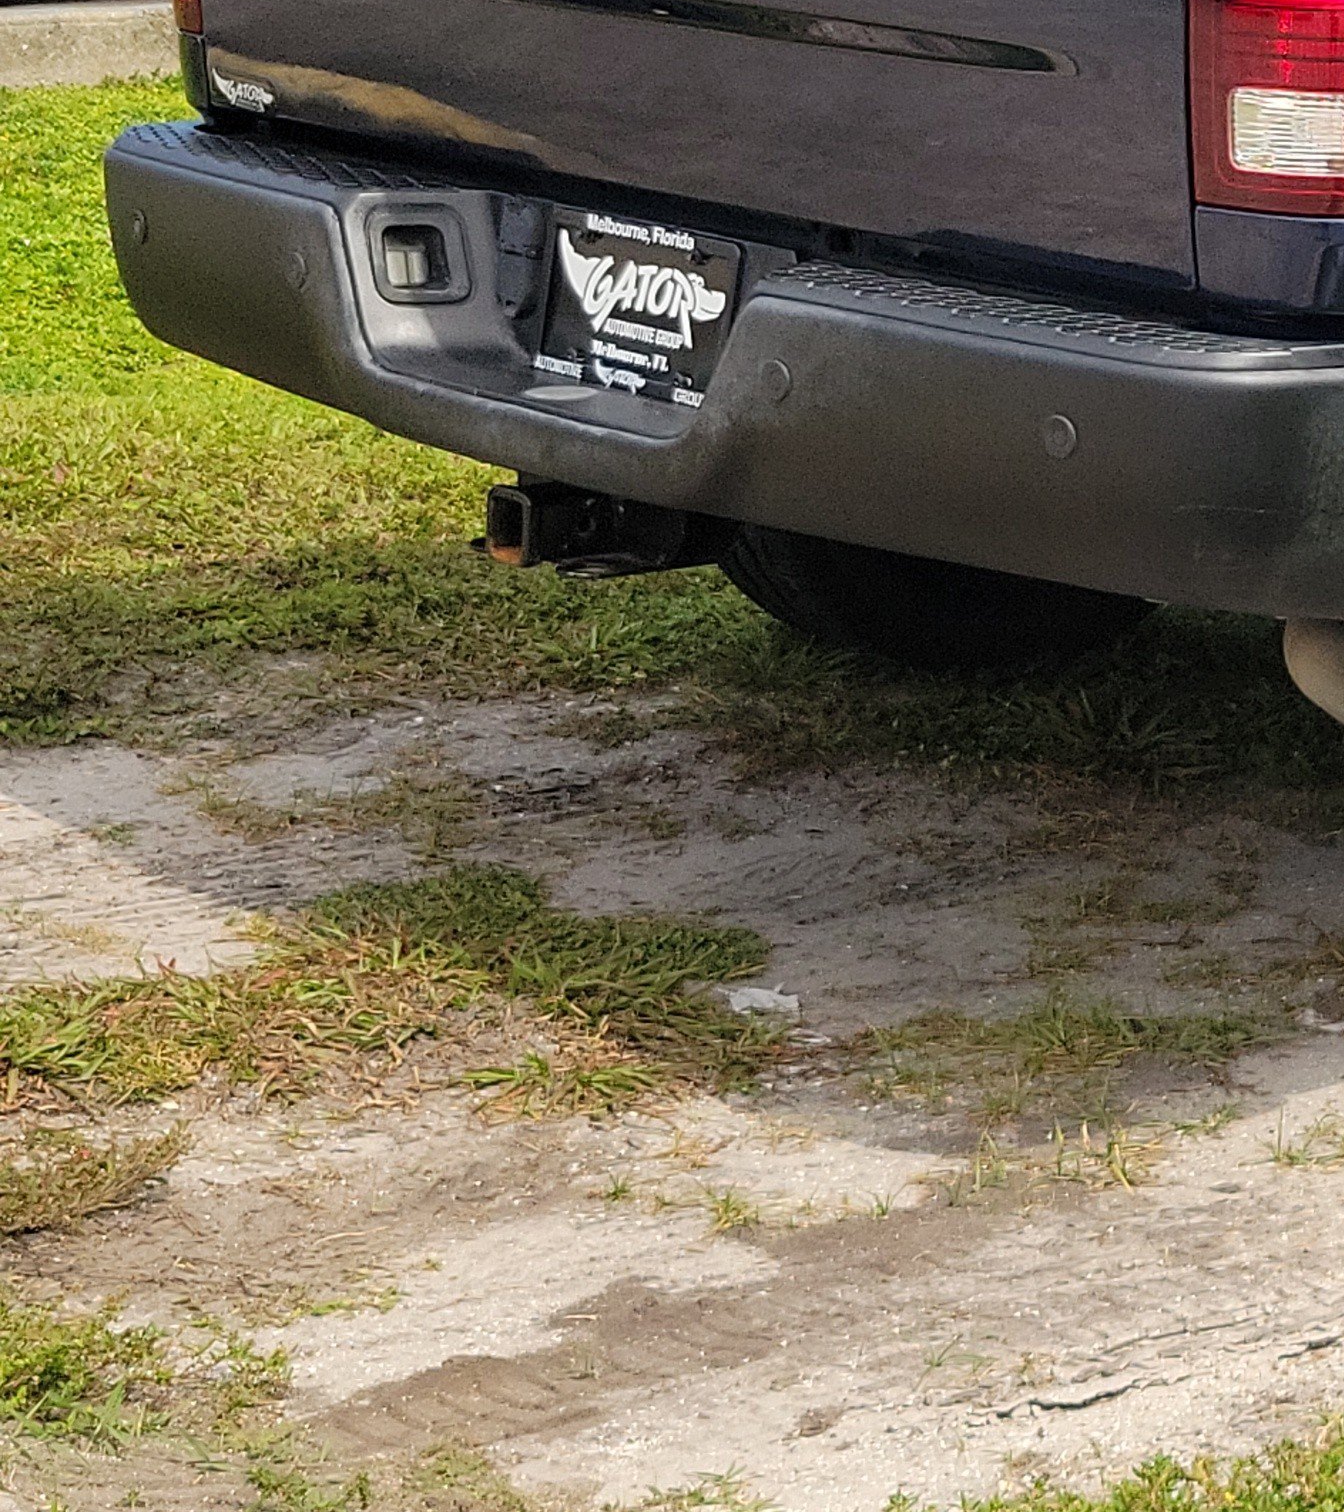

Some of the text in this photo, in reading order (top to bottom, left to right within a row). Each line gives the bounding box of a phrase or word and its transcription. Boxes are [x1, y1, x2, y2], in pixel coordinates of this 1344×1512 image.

[587, 214, 695, 251] Melbourne, Florida
[583, 255, 696, 350] GATOR
[603, 317, 655, 344] AUTOMOTIVE
